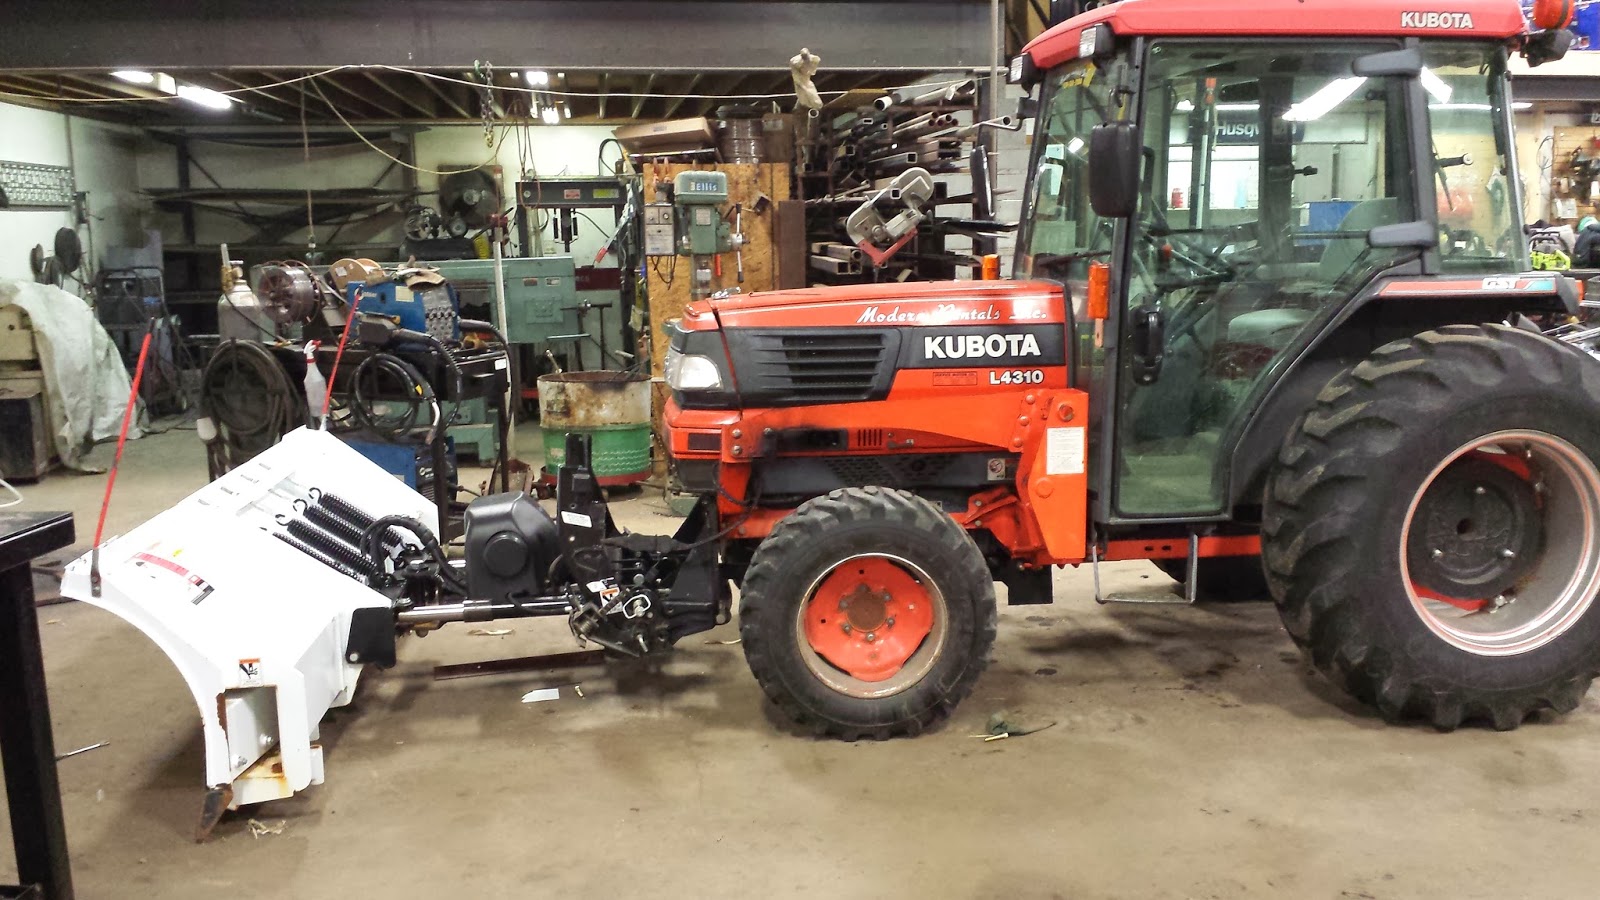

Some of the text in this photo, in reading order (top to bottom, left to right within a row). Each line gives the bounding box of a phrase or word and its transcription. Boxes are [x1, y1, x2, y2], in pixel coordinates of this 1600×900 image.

[1401, 11, 1474, 29] KUBOTA
[696, 182, 717, 191] Ellis
[857, 306, 930, 323] Modern
[936, 303, 1000, 321] Rntals
[924, 333, 1041, 359] KUBOTA
[989, 369, 1044, 385] L4310
